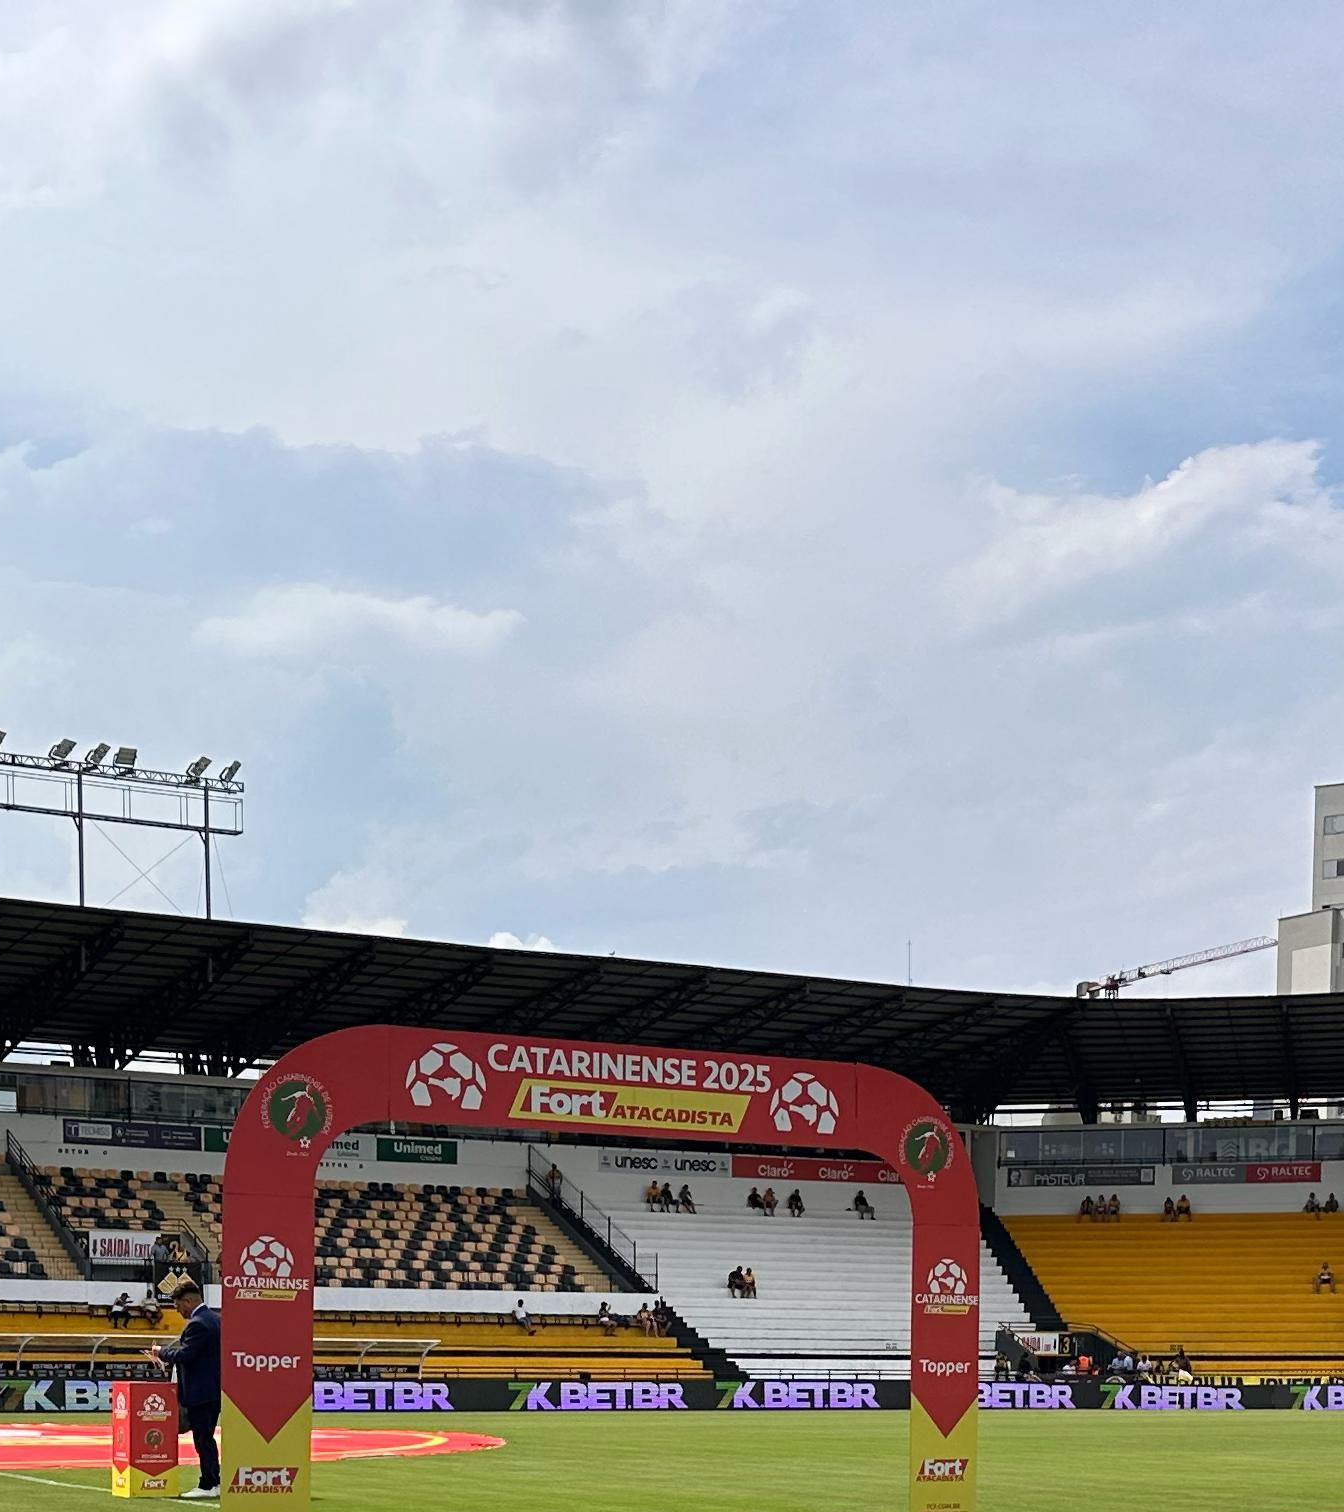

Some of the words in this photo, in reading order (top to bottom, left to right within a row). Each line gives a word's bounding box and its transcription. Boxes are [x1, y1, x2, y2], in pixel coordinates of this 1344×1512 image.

[487, 1043, 697, 1085] CATARINENSE
[702, 1060, 772, 1093] 2025
[530, 1085, 607, 1118] Fort
[612, 1104, 734, 1127] ATACADISTA
[393, 1141, 442, 1155] Unimed
[614, 1155, 658, 1169] unesc
[674, 1157, 716, 1172] unesc
[758, 1162, 789, 1177] Claro
[818, 1165, 849, 1180] Claro
[877, 1169, 899, 1182] Clar
[1034, 1172, 1086, 1185] PASTEUR
[1195, 1167, 1236, 1177] RALTEC
[1271, 1165, 1312, 1177] RALTEC
[223, 1275, 311, 1290] CATARINENSE
[915, 1293, 979, 1305] CATARINENSE
[231, 1351, 301, 1372] Topper
[918, 1357, 971, 1375] Topper
[923, 1458, 964, 1477] Fort
[238, 1467, 292, 1486] Fort
[227, 1485, 293, 1494] ATACADISTA
